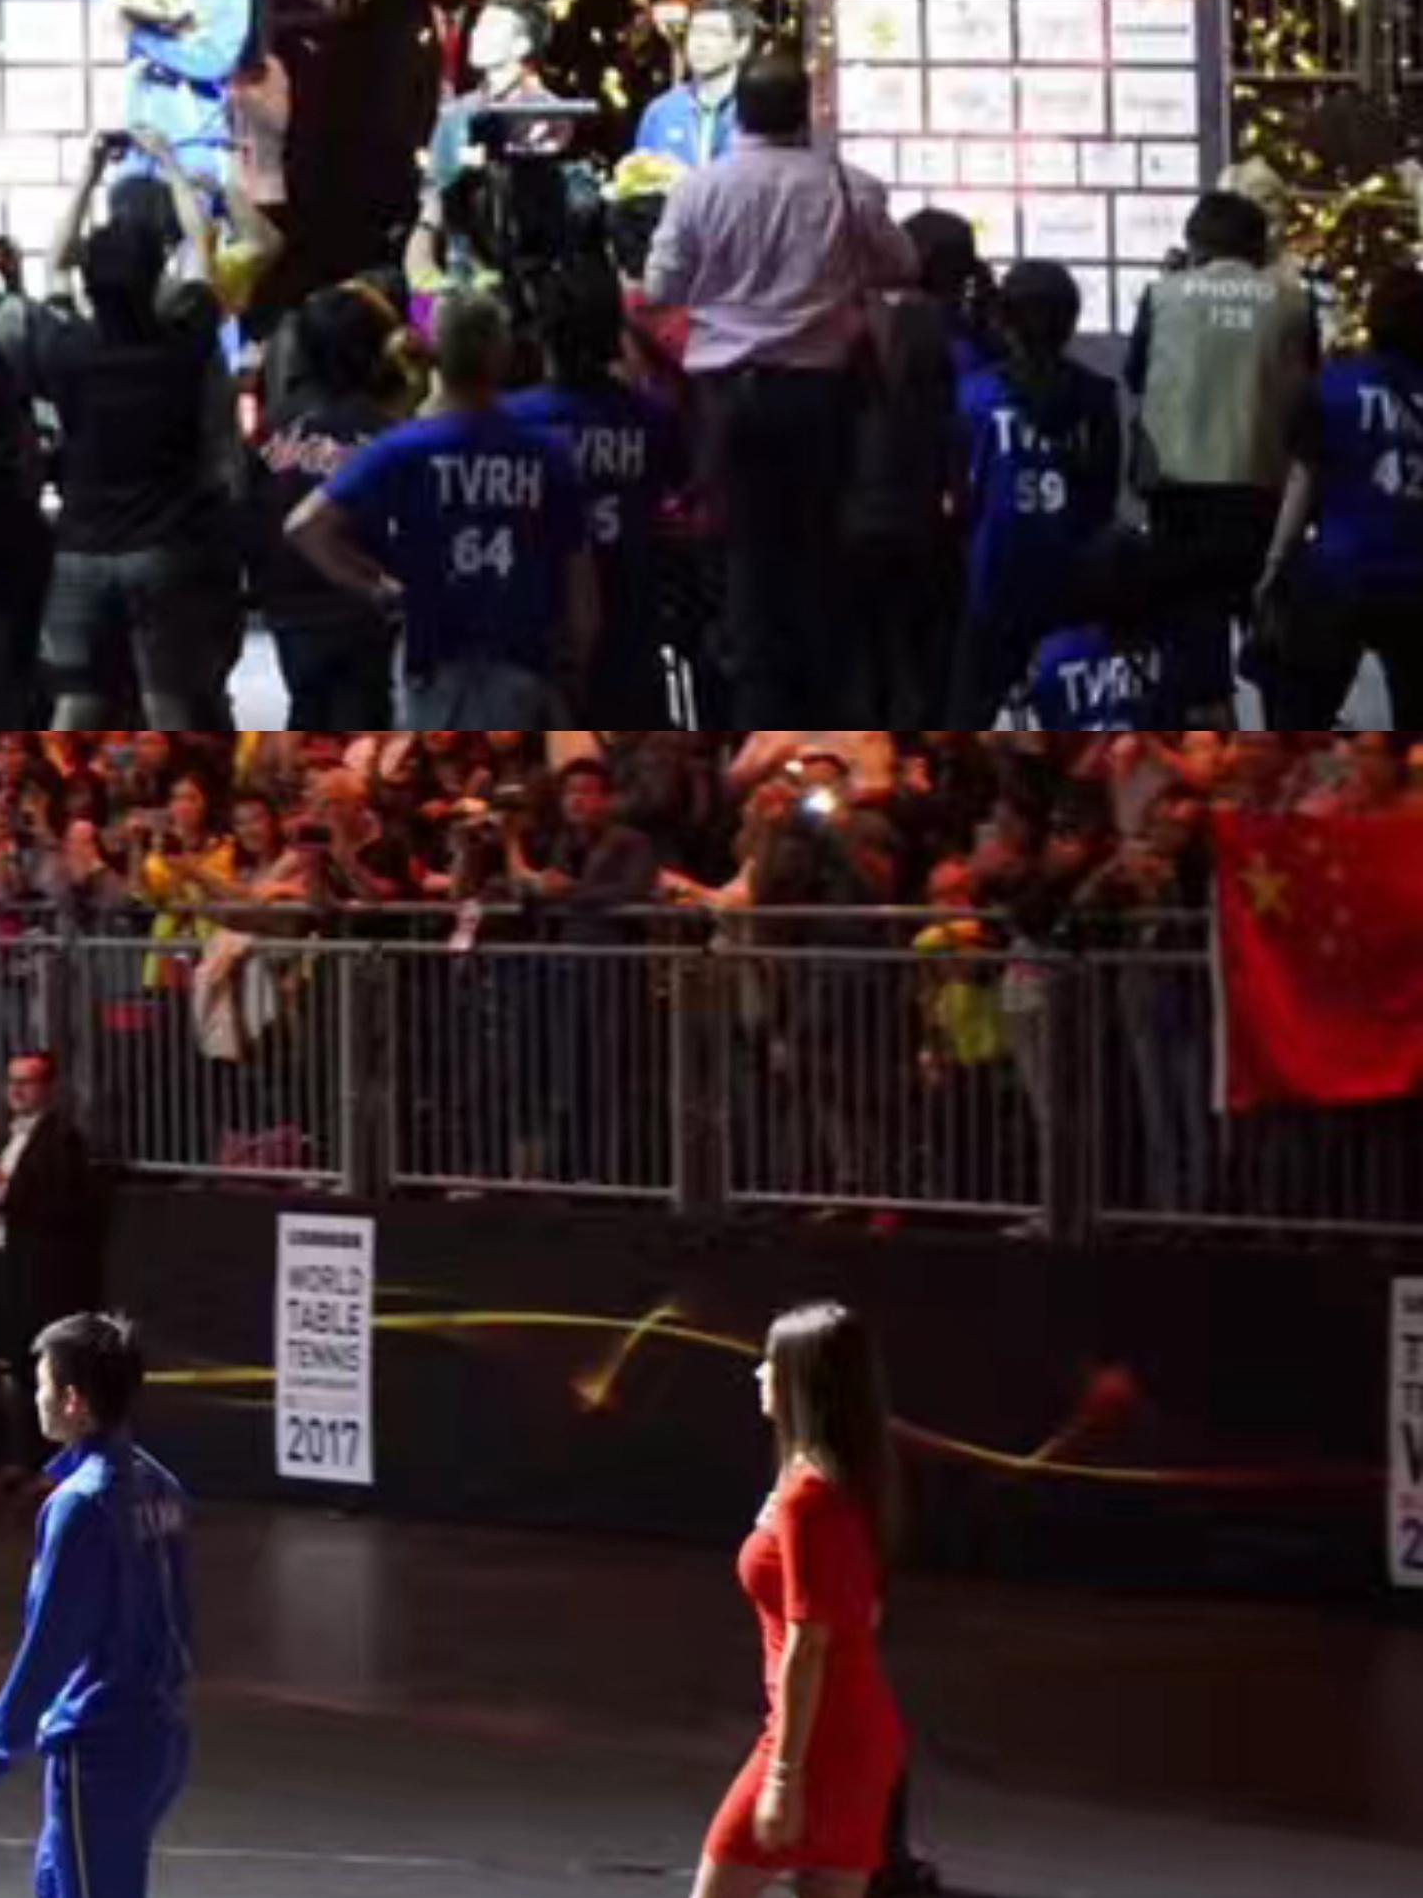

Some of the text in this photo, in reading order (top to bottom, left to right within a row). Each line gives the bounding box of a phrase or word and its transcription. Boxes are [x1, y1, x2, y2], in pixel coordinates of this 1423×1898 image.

[429, 454, 544, 509] TVRH
[451, 526, 514, 577] 64
[287, 1264, 363, 1296] WORLD
[286, 1297, 361, 1336] TABLE
[286, 1337, 360, 1373] TENNIS
[286, 1414, 361, 1467] 2017
